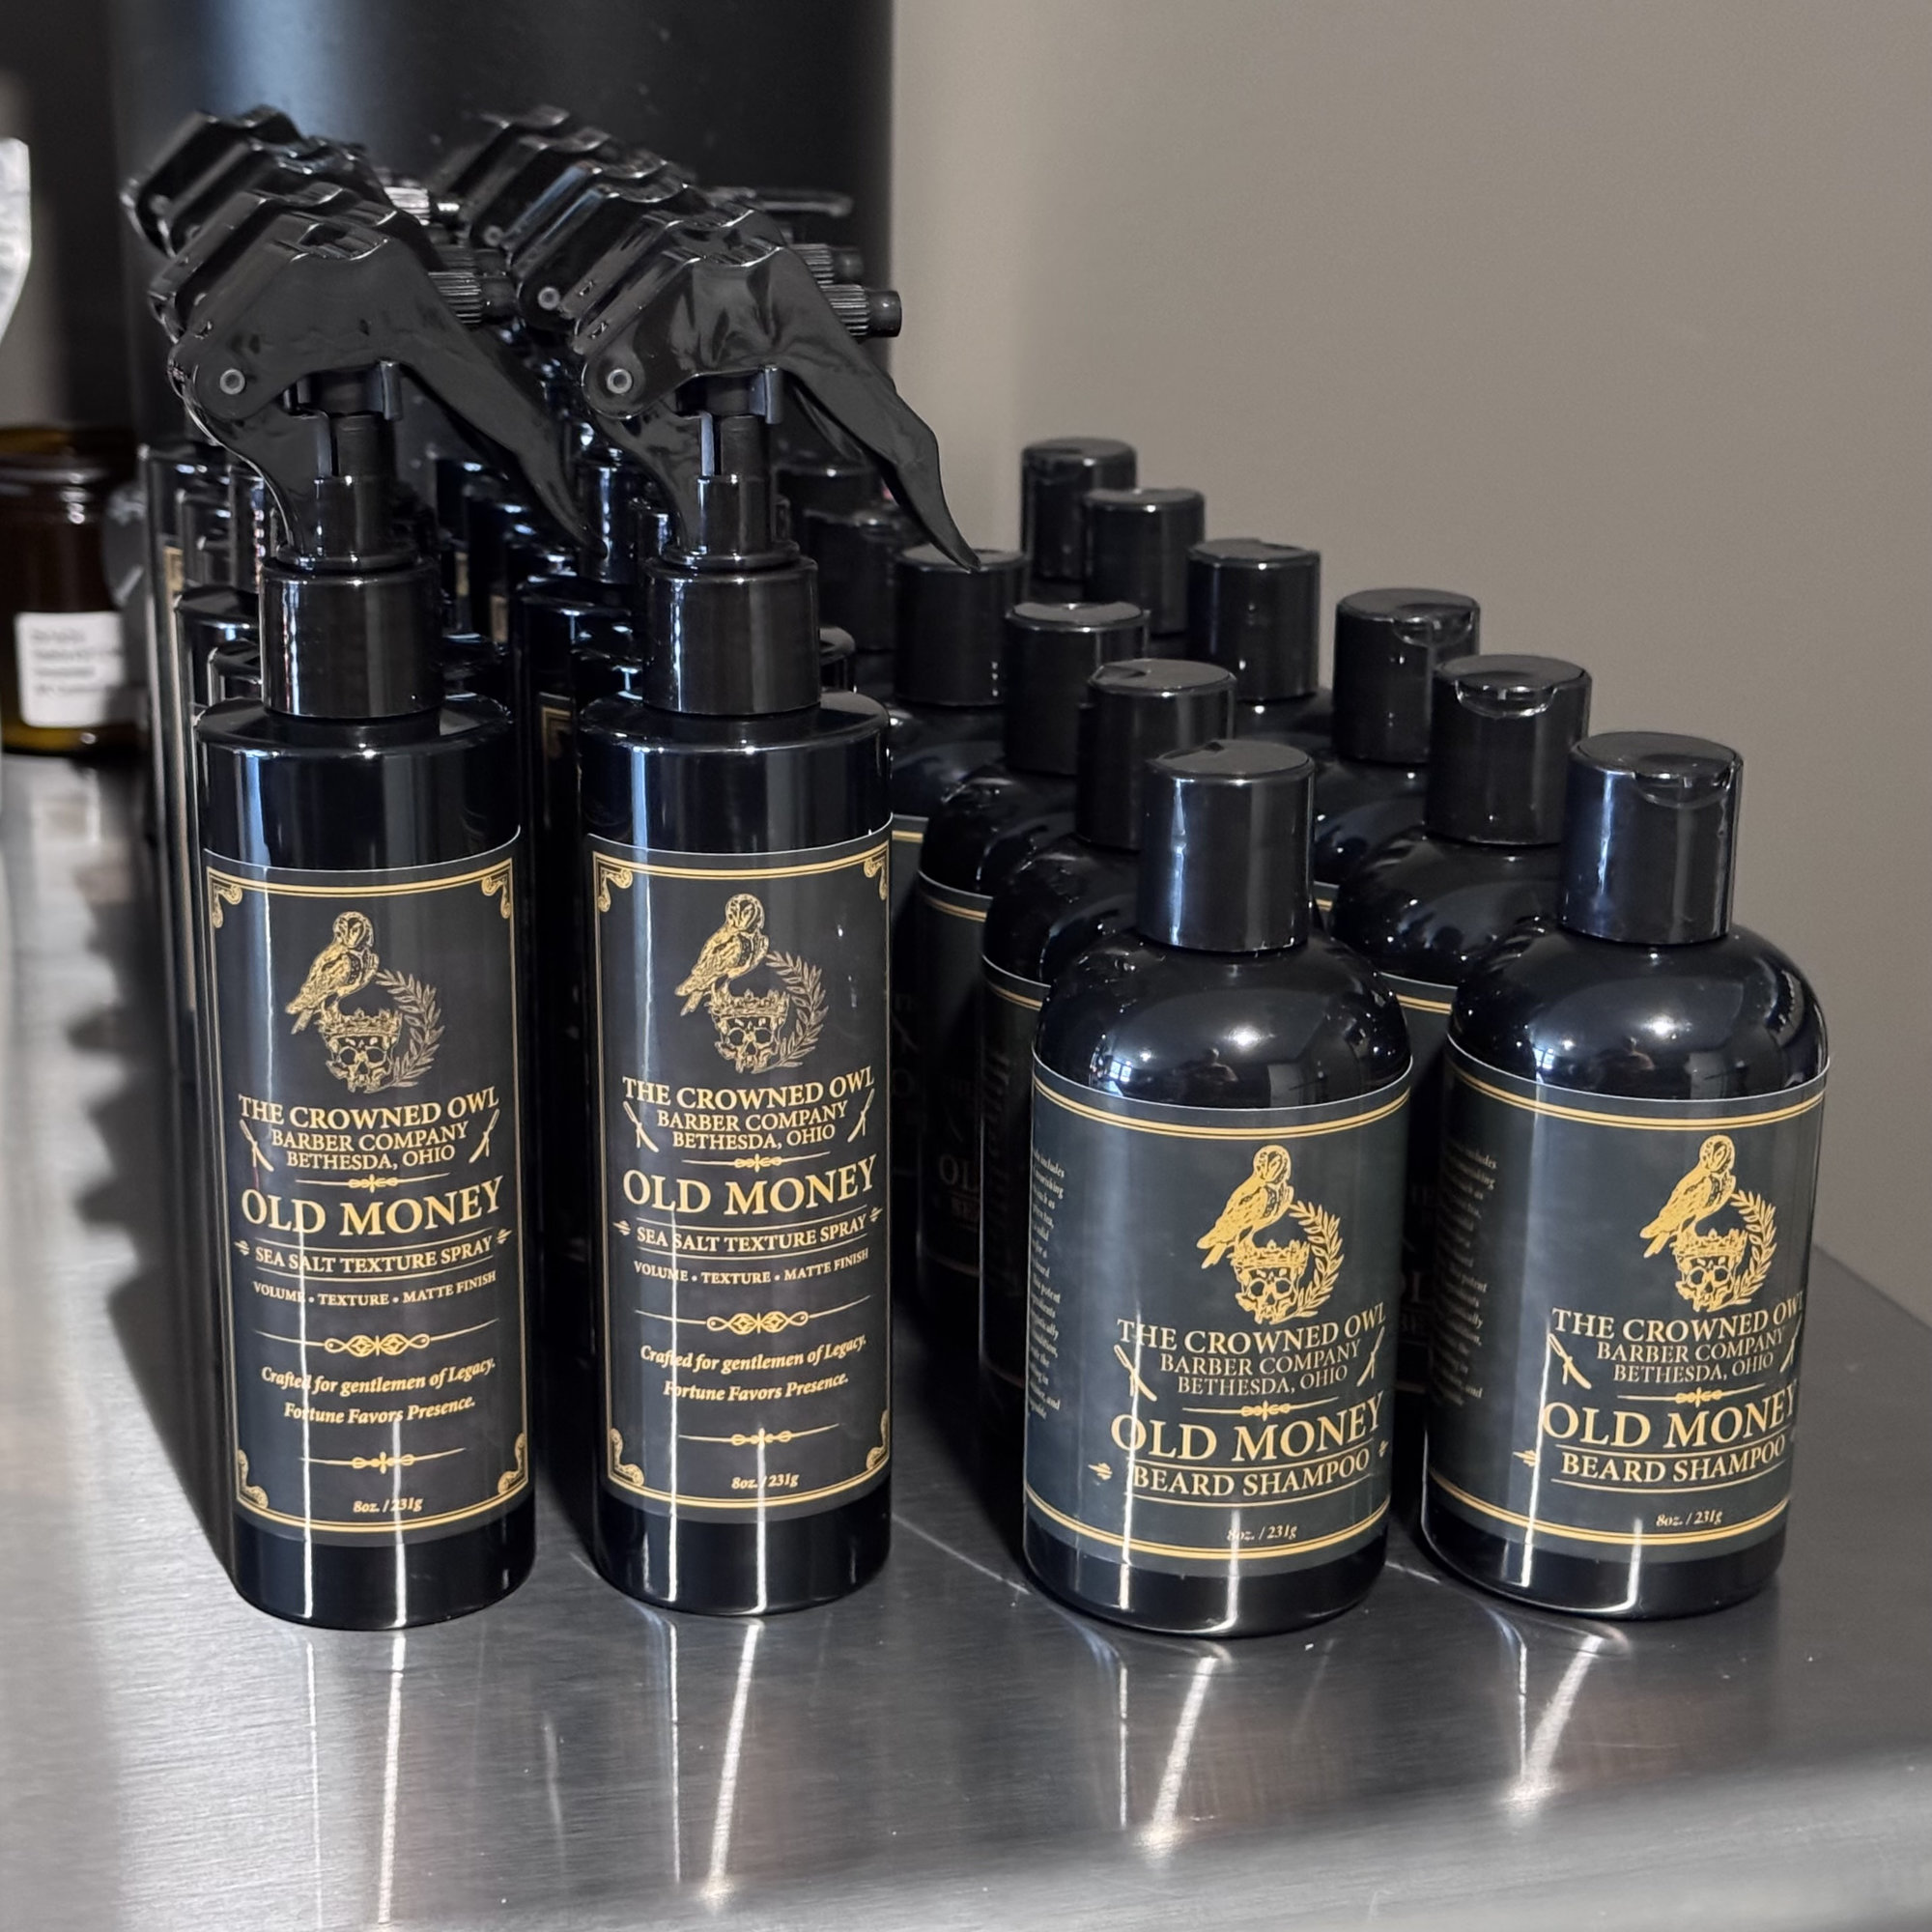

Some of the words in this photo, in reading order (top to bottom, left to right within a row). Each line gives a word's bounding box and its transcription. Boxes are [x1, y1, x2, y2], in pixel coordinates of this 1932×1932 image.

[623, 1077, 670, 1106] THE
[677, 1083, 823, 1109] CROWNED
[830, 1066, 874, 1097] OWL
[239, 1094, 284, 1124] THE
[290, 1102, 440, 1131] CROWNED
[447, 1086, 499, 1118] OWL
[657, 1110, 740, 1131] BARBER
[746, 1100, 847, 1130] COMPANY
[272, 1129, 354, 1151] BARBER
[359, 1122, 469, 1151] COMPANY
[672, 1131, 781, 1151] BETHESDA,
[786, 1124, 836, 1146] OHIO
[287, 1151, 398, 1170] BETHESDA,
[403, 1145, 455, 1166] OHIO
[623, 1170, 711, 1212] OLD
[724, 1154, 876, 1214] MONEY
[242, 1189, 326, 1234] OLD
[340, 1176, 503, 1236] MONEY
[638, 1227, 668, 1246] SEA
[672, 1235, 720, 1252] SALT
[724, 1230, 816, 1252] TEXTURE
[821, 1213, 867, 1241] SPRAY
[256, 1247, 285, 1267] SEA
[290, 1255, 335, 1272] SALT
[341, 1250, 437, 1273] TEXTURE
[441, 1236, 492, 1257] SPRAY
[634, 1261, 688, 1281] VOLUME
[701, 1272, 771, 1284] TEXTURE
[784, 1264, 831, 1280] MATTE
[834, 1248, 868, 1271] FINISH
[253, 1282, 304, 1302] VOLUME
[319, 1293, 389, 1305] TEXTURE
[403, 1287, 454, 1303] MATTE
[457, 1270, 497, 1294] FINISH
[1118, 1319, 1177, 1350] THE
[1184, 1322, 1338, 1354] CROWNED
[1345, 1302, 1385, 1337] OWL
[1552, 1307, 1614, 1339] THE
[1623, 1310, 1768, 1343] CROWNED
[640, 1346, 692, 1368] Crafted
[694, 1354, 719, 1372] for
[722, 1354, 804, 1374] gentlemen
[808, 1346, 824, 1364] of
[824, 1334, 867, 1359] Legacy.
[1160, 1353, 1252, 1376] BARBER
[1259, 1339, 1360, 1375] COMPANY
[1597, 1342, 1689, 1362] BARBER
[1695, 1327, 1784, 1362] COMPANY
[262, 1367, 310, 1389] Crafted
[312, 1377, 338, 1393] for
[341, 1378, 425, 1397] gentlemen
[430, 1370, 447, 1388] of
[448, 1357, 496, 1381] Legacy.
[1178, 1377, 1294, 1396] BETHESDA,
[1300, 1365, 1348, 1389] OHIO
[1613, 1365, 1726, 1383] BETHESDA,
[1732, 1352, 1773, 1376] OHIO
[664, 1380, 724, 1400] Fortune
[728, 1386, 781, 1400] Favors
[785, 1373, 848, 1396] Presence.
[284, 1403, 344, 1423] Fortune
[348, 1410, 403, 1424] Favors
[407, 1396, 475, 1420] Presence.
[1111, 1414, 1217, 1460] OLD
[1232, 1390, 1383, 1462] MONEY
[1544, 1403, 1650, 1447] OLD
[1663, 1378, 1797, 1449] MONEY
[1133, 1465, 1234, 1496] BEARD
[1243, 1449, 1369, 1495] SHAMPOO
[1562, 1453, 1665, 1483] BEARD
[1673, 1435, 1785, 1482] SHAMPOO
[732, 1477, 758, 1489] 8oz.
[768, 1474, 799, 1487] 231g
[354, 1501, 380, 1513] 8oz.
[391, 1498, 422, 1512] 231g
[1657, 1515, 1685, 1526] 8oz.
[1693, 1511, 1722, 1525] 231g
[1267, 1524, 1297, 1540] 231g
